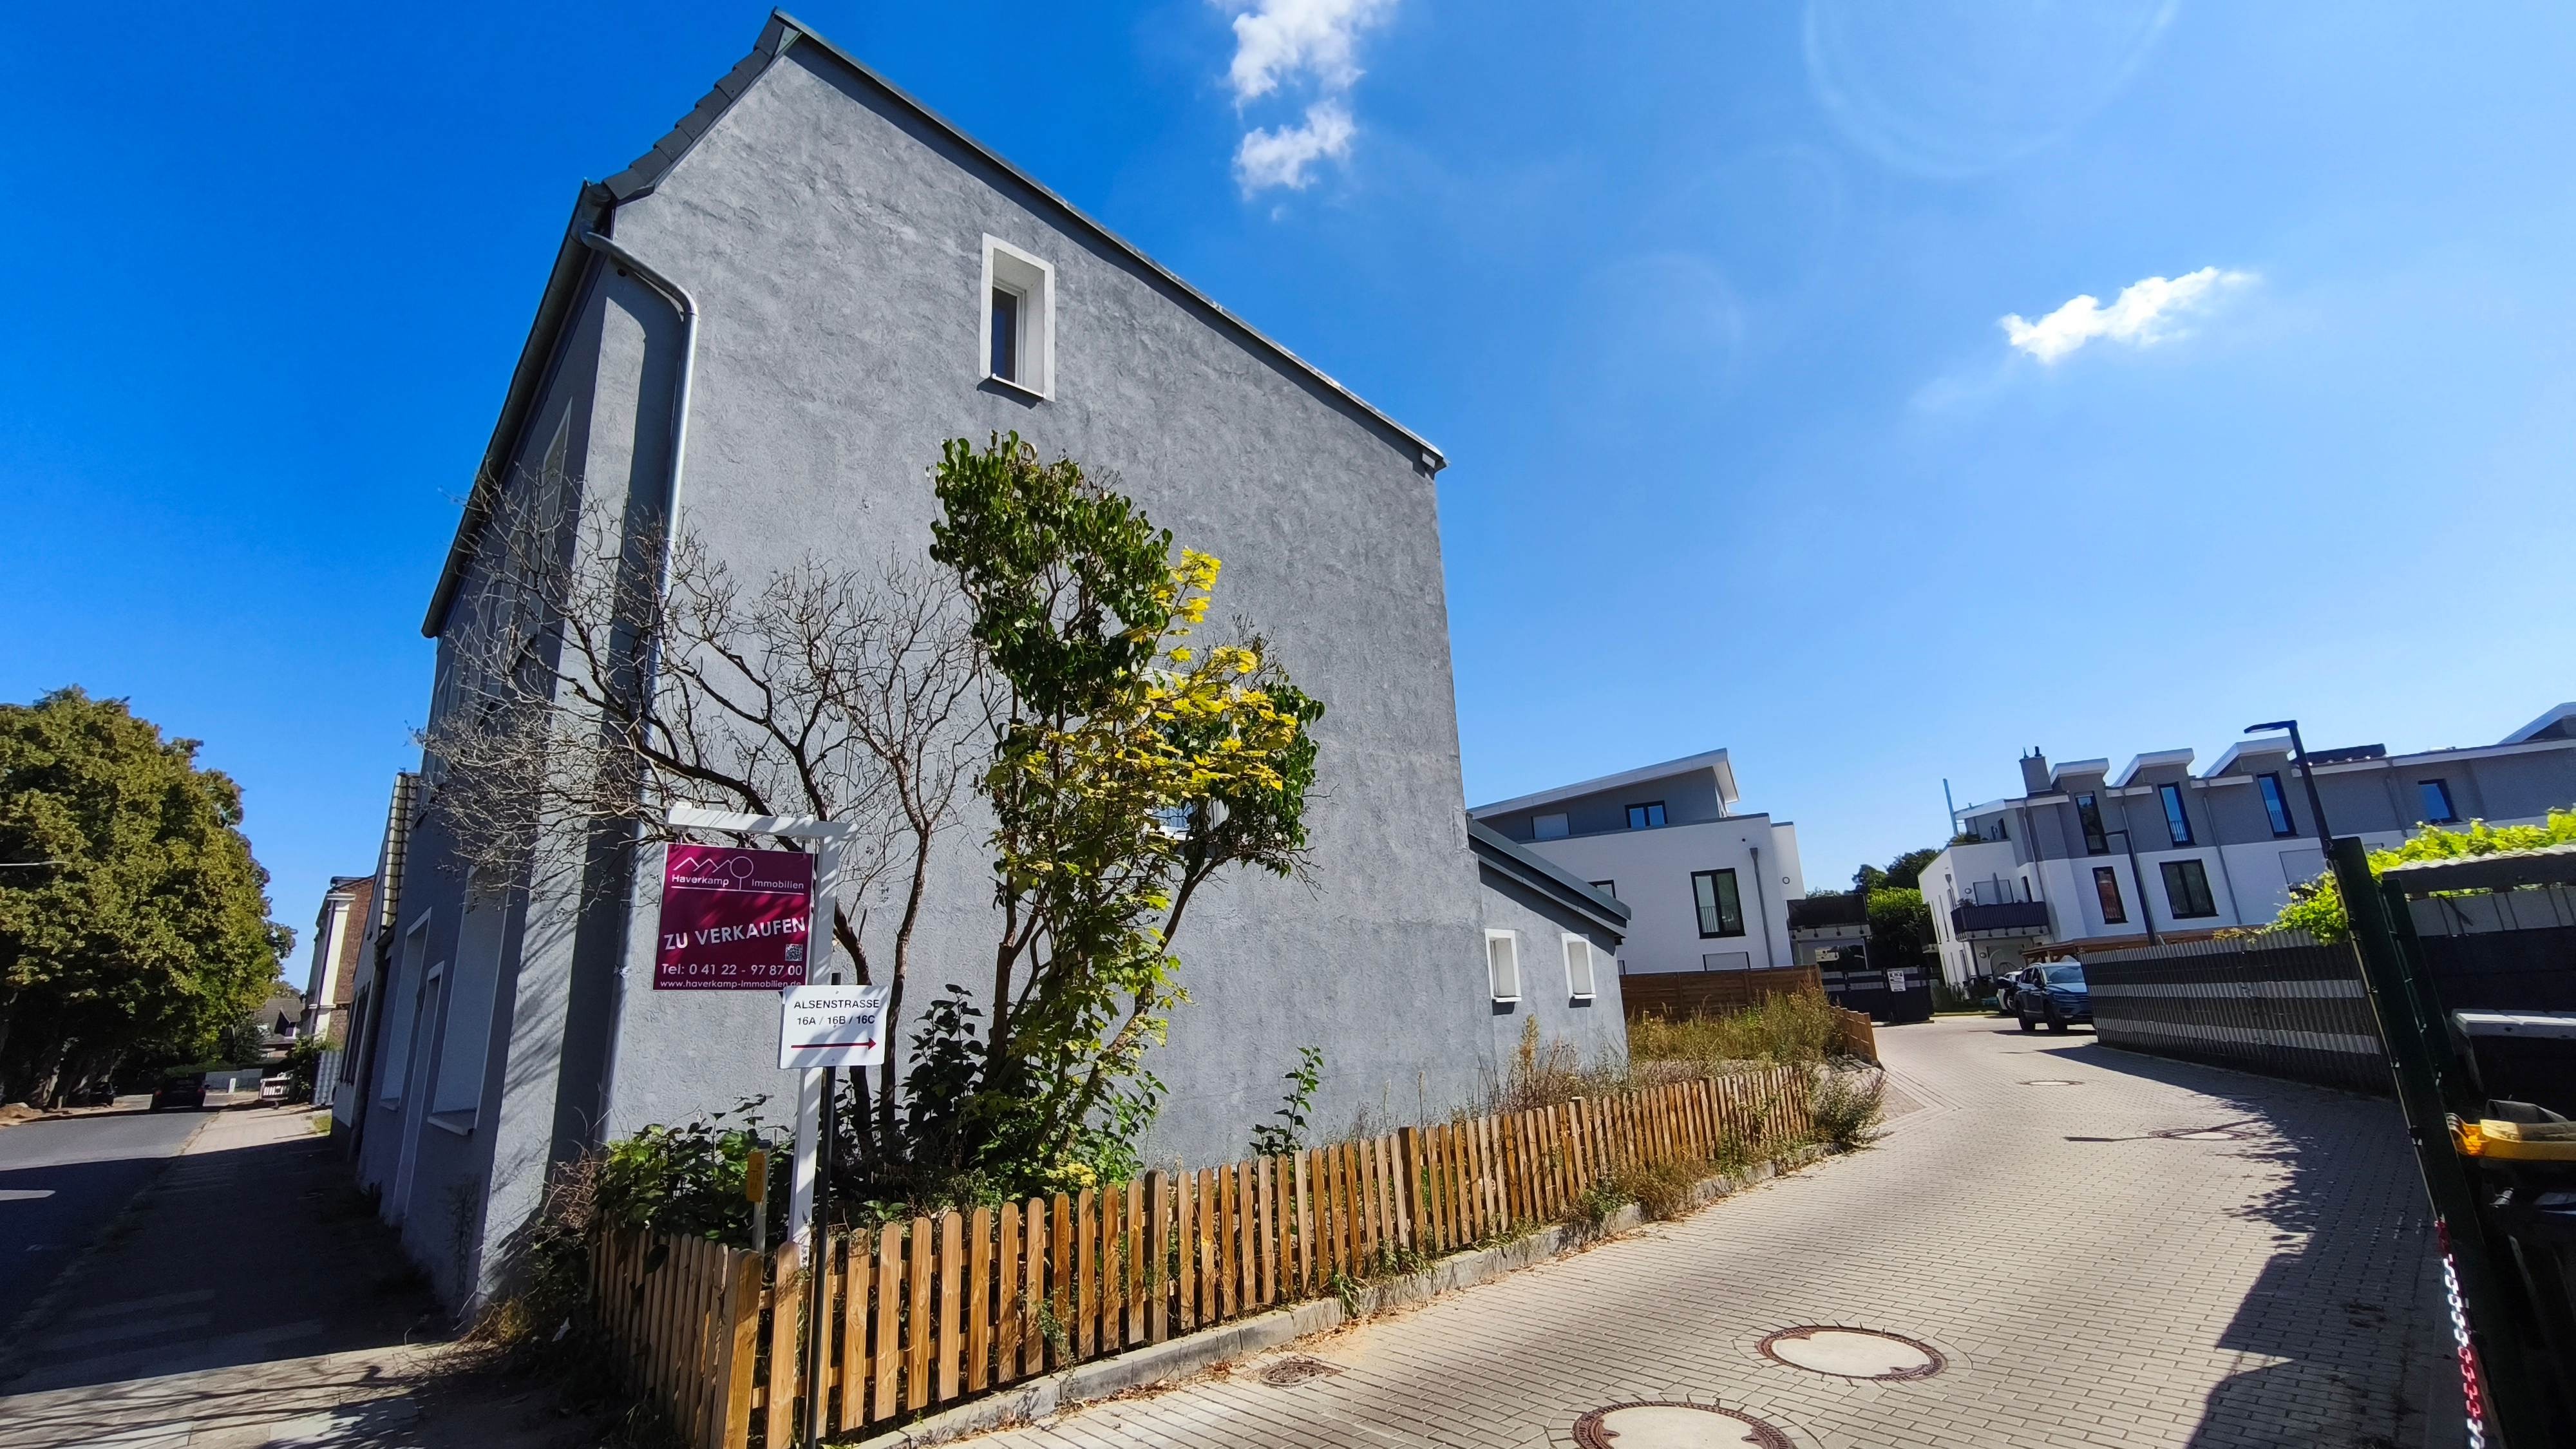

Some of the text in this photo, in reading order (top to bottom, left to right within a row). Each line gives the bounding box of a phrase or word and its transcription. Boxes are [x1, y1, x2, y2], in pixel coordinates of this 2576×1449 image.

[672, 874, 804, 889] Haverkamp Immobilien
[664, 917, 805, 950] ZU VERKAUFEN
[662, 963, 684, 974] Tel:
[689, 964, 697, 974] 0
[701, 964, 715, 974] 41
[721, 965, 736, 975] 22
[751, 965, 764, 975] 97
[770, 965, 784, 975] 87
[788, 965, 802, 976] 00
[660, 980, 801, 989] www.haverkamp-immobiliende
[794, 999, 880, 1009] ALSENSTRASSE
[797, 1016, 816, 1025] 16A
[828, 1016, 846, 1025] 16B
[857, 1015, 875, 1024] 16C
